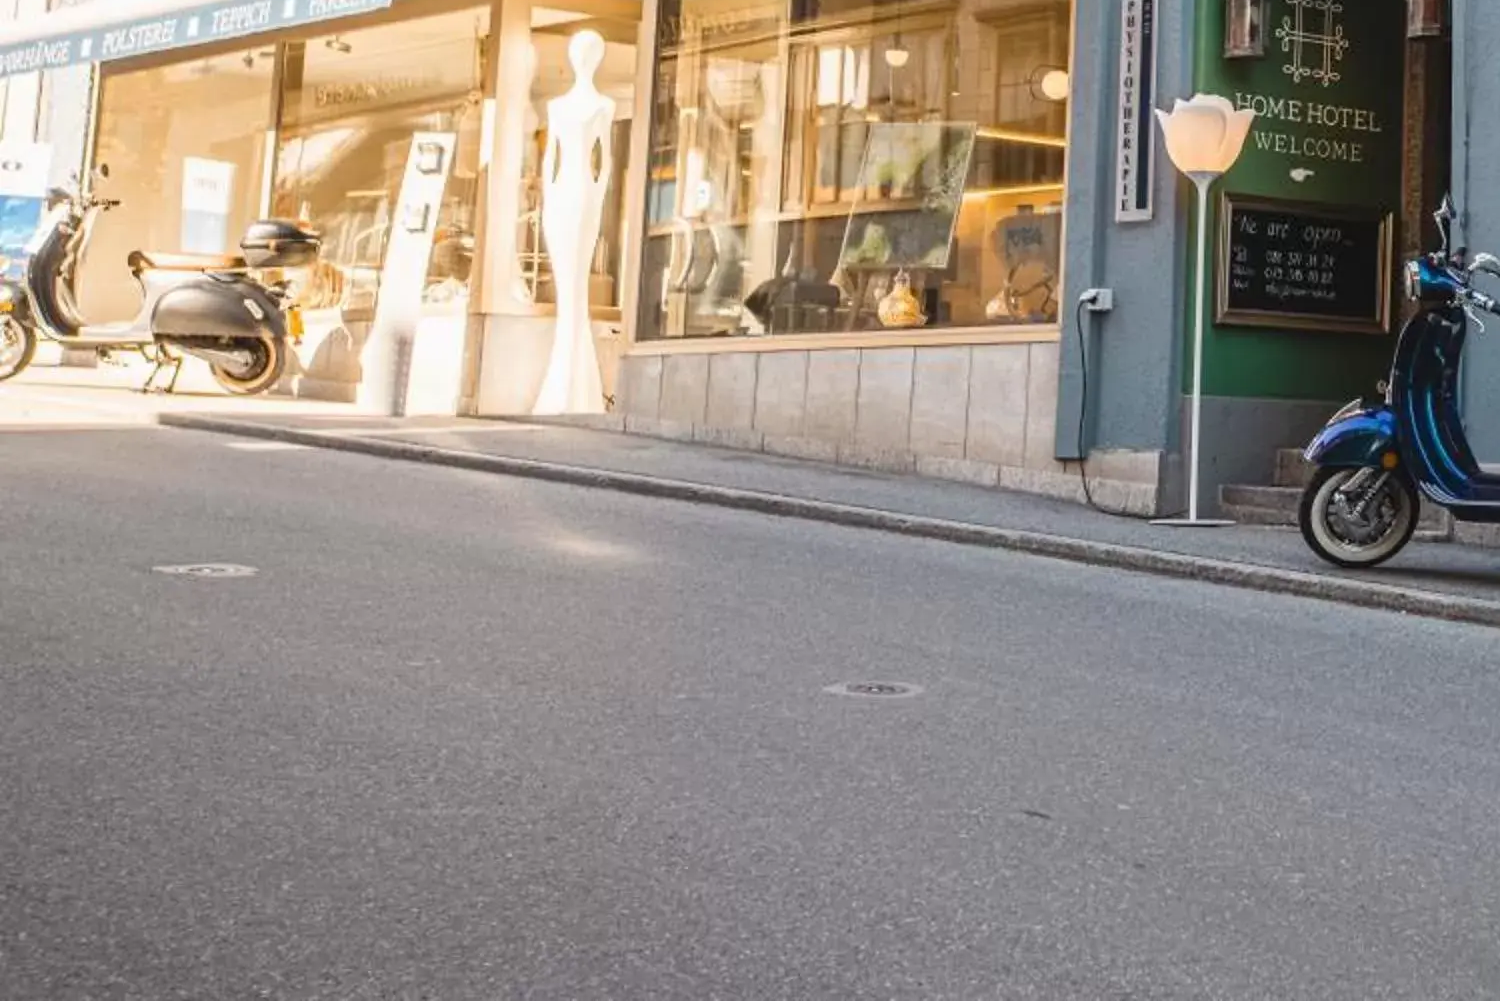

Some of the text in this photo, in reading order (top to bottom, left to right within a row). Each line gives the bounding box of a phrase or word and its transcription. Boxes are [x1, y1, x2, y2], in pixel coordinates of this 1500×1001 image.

[102, 19, 177, 55] POLSTEREI
[211, 0, 273, 35] TEPPICH
[1120, 0, 1136, 212] PHYSIOTHERAPIE
[1236, 92, 1382, 133] HOME HOTEL
[1253, 130, 1363, 162] WELCOME
